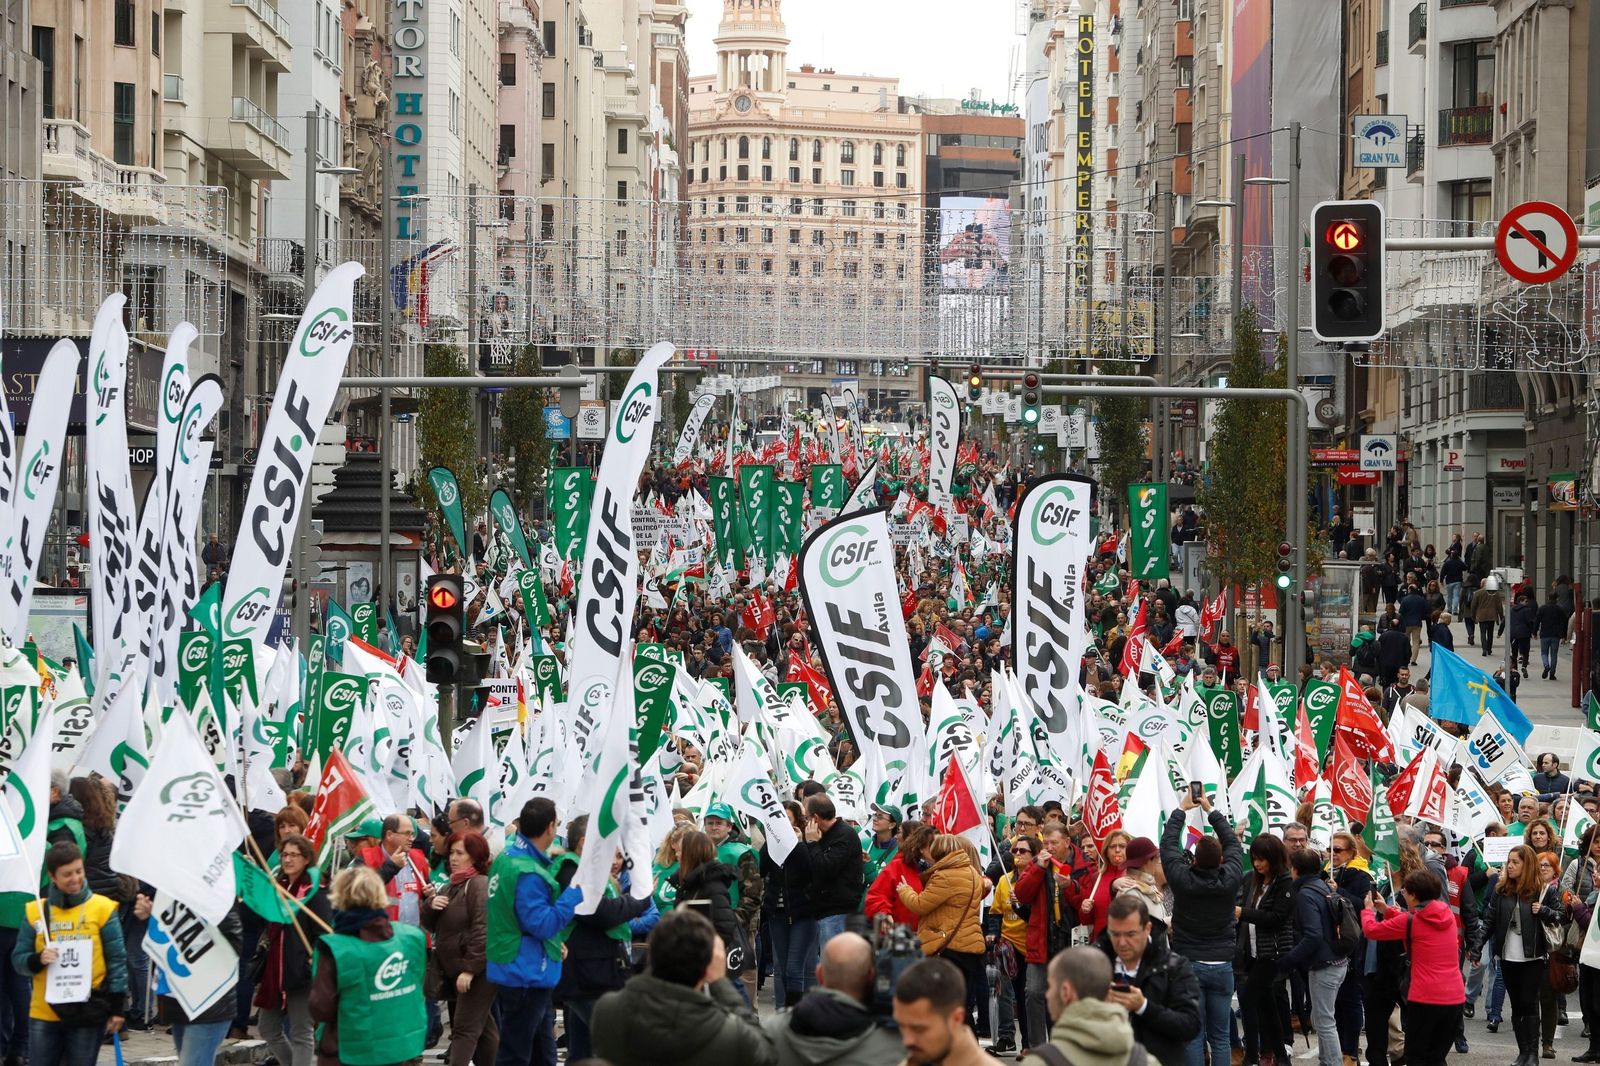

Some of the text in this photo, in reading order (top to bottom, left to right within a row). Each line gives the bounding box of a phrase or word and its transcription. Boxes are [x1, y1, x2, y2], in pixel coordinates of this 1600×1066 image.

[1077, 15, 1094, 119] HOTEL
[1360, 120, 1381, 137] CENTRO
[395, 92, 424, 240] HOTEL
[1360, 152, 1383, 164] GRAN
[1364, 459, 1381, 467] GRAN
[1448, 452, 1459, 465] P
[1040, 502, 1081, 528] CSIF
[830, 539, 878, 568] CSIF
[586, 486, 631, 657] CSIF
[1060, 564, 1076, 610] Ávila
[874, 592, 891, 634] Ávila
[1025, 554, 1071, 734] CSIF
[642, 671, 669, 686] CSIF
[825, 601, 910, 750] CSIF
[332, 688, 362, 703] CSIF
[1213, 701, 1232, 712] CSIF
[1313, 692, 1336, 705] CSIF
[1145, 720, 1169, 732] CSIF
[1476, 732, 1505, 763] STAJ
[161, 899, 215, 964] STAJ
